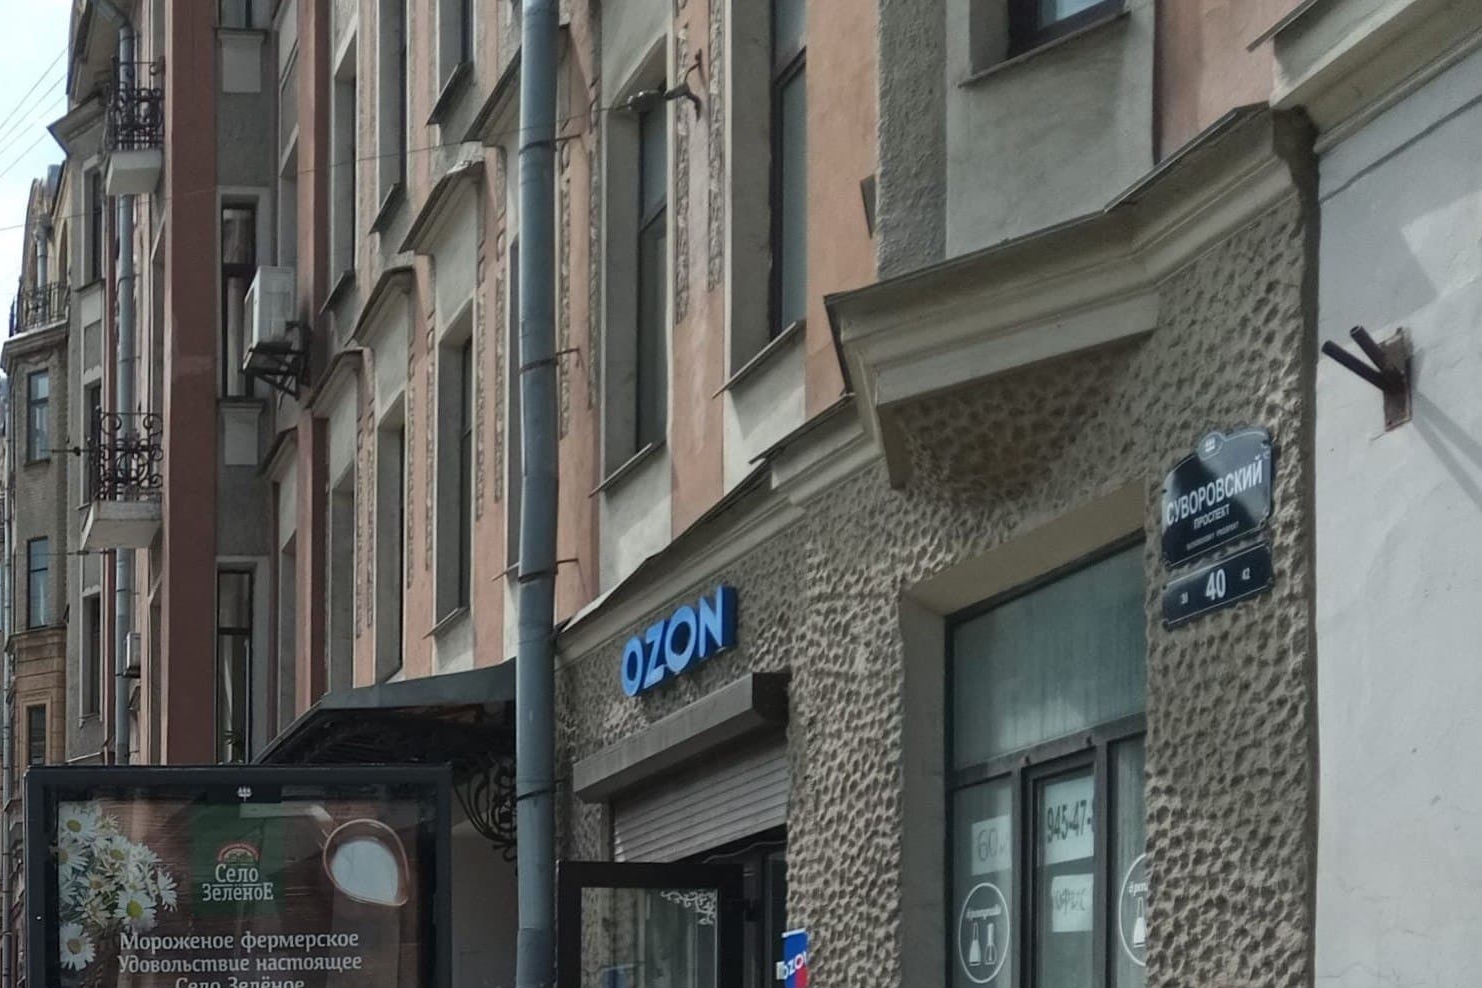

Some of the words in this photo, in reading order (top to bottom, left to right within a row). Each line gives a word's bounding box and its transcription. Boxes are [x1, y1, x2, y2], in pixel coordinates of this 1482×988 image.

[1167, 455, 1263, 526] СУВОРОВСКИЙ
[1193, 503, 1230, 530] ПРОСПЕКТ
[1205, 568, 1226, 601] 40
[620, 584, 732, 697] OZON
[215, 863, 259, 883] Село
[120, 932, 234, 953] Мороженое
[241, 931, 359, 953] фермерское
[118, 954, 250, 974] Удовольствие
[256, 953, 363, 974] настоящее
